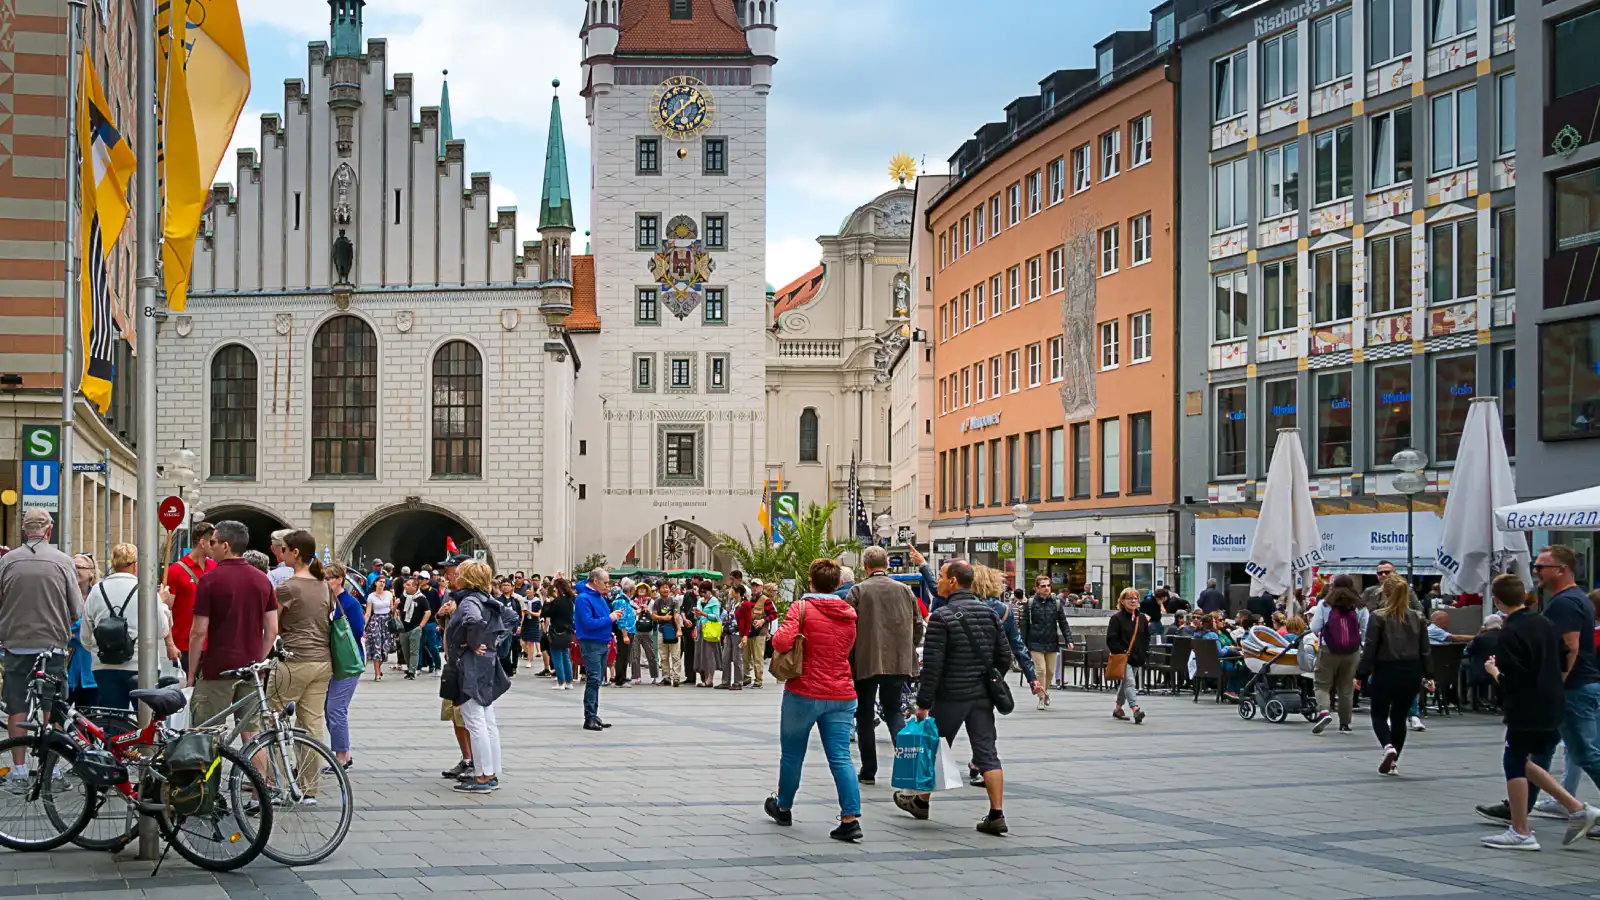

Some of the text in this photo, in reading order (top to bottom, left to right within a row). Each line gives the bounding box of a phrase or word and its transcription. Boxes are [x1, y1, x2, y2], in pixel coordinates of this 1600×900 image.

[30, 429, 53, 456] S
[30, 464, 51, 491] U
[778, 495, 794, 515] S
[1507, 510, 1600, 529] Restauran
[1212, 534, 1247, 545] Rischart
[1371, 531, 1413, 544] Rischar
[1130, 545, 1151, 553] ROCHER
